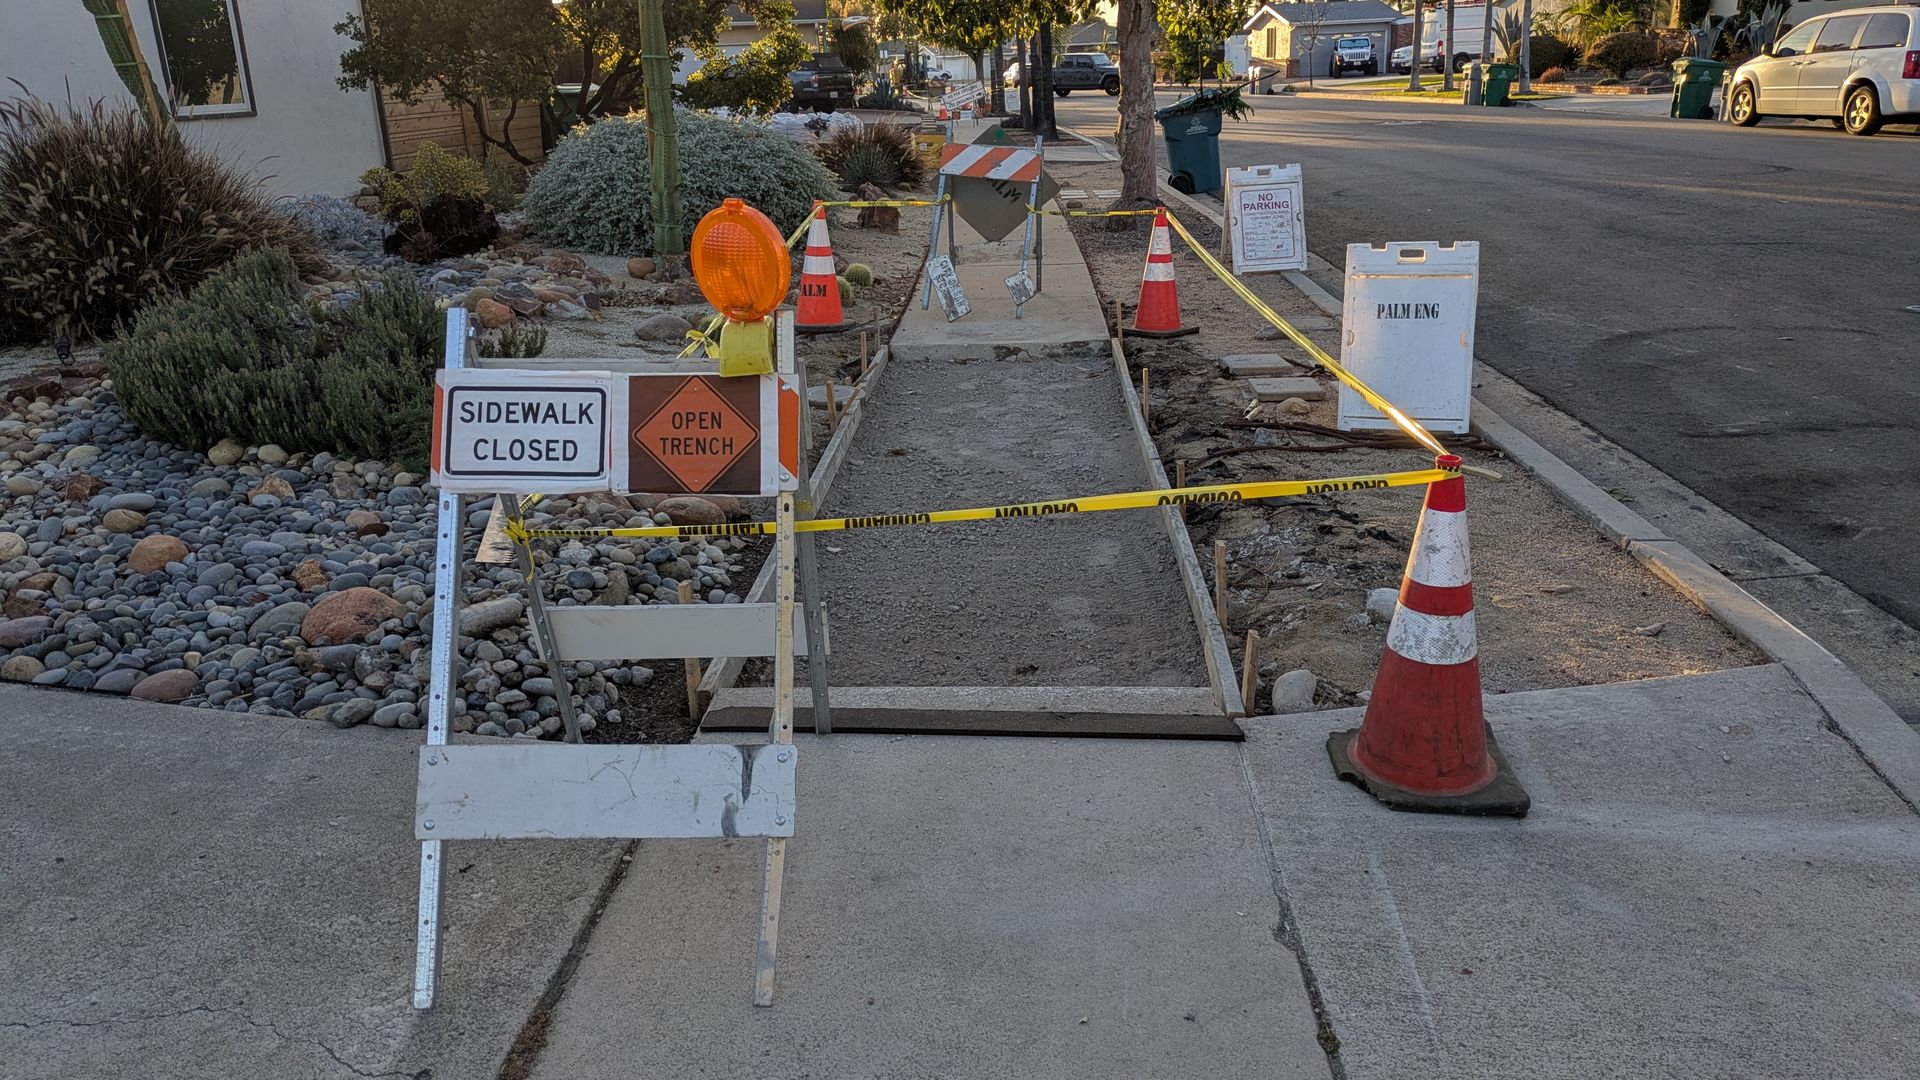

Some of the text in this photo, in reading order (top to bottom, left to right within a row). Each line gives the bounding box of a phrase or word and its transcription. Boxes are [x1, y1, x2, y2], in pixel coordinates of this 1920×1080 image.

[1243, 201, 1289, 211] PARKING
[1258, 193, 1273, 201] NO
[1376, 303, 1440, 320] PALM ENG
[459, 401, 594, 425] SIDEWALK
[671, 411, 723, 430] OPEN
[472, 438, 578, 462] CLOSED
[659, 437, 734, 456] TRENCH
